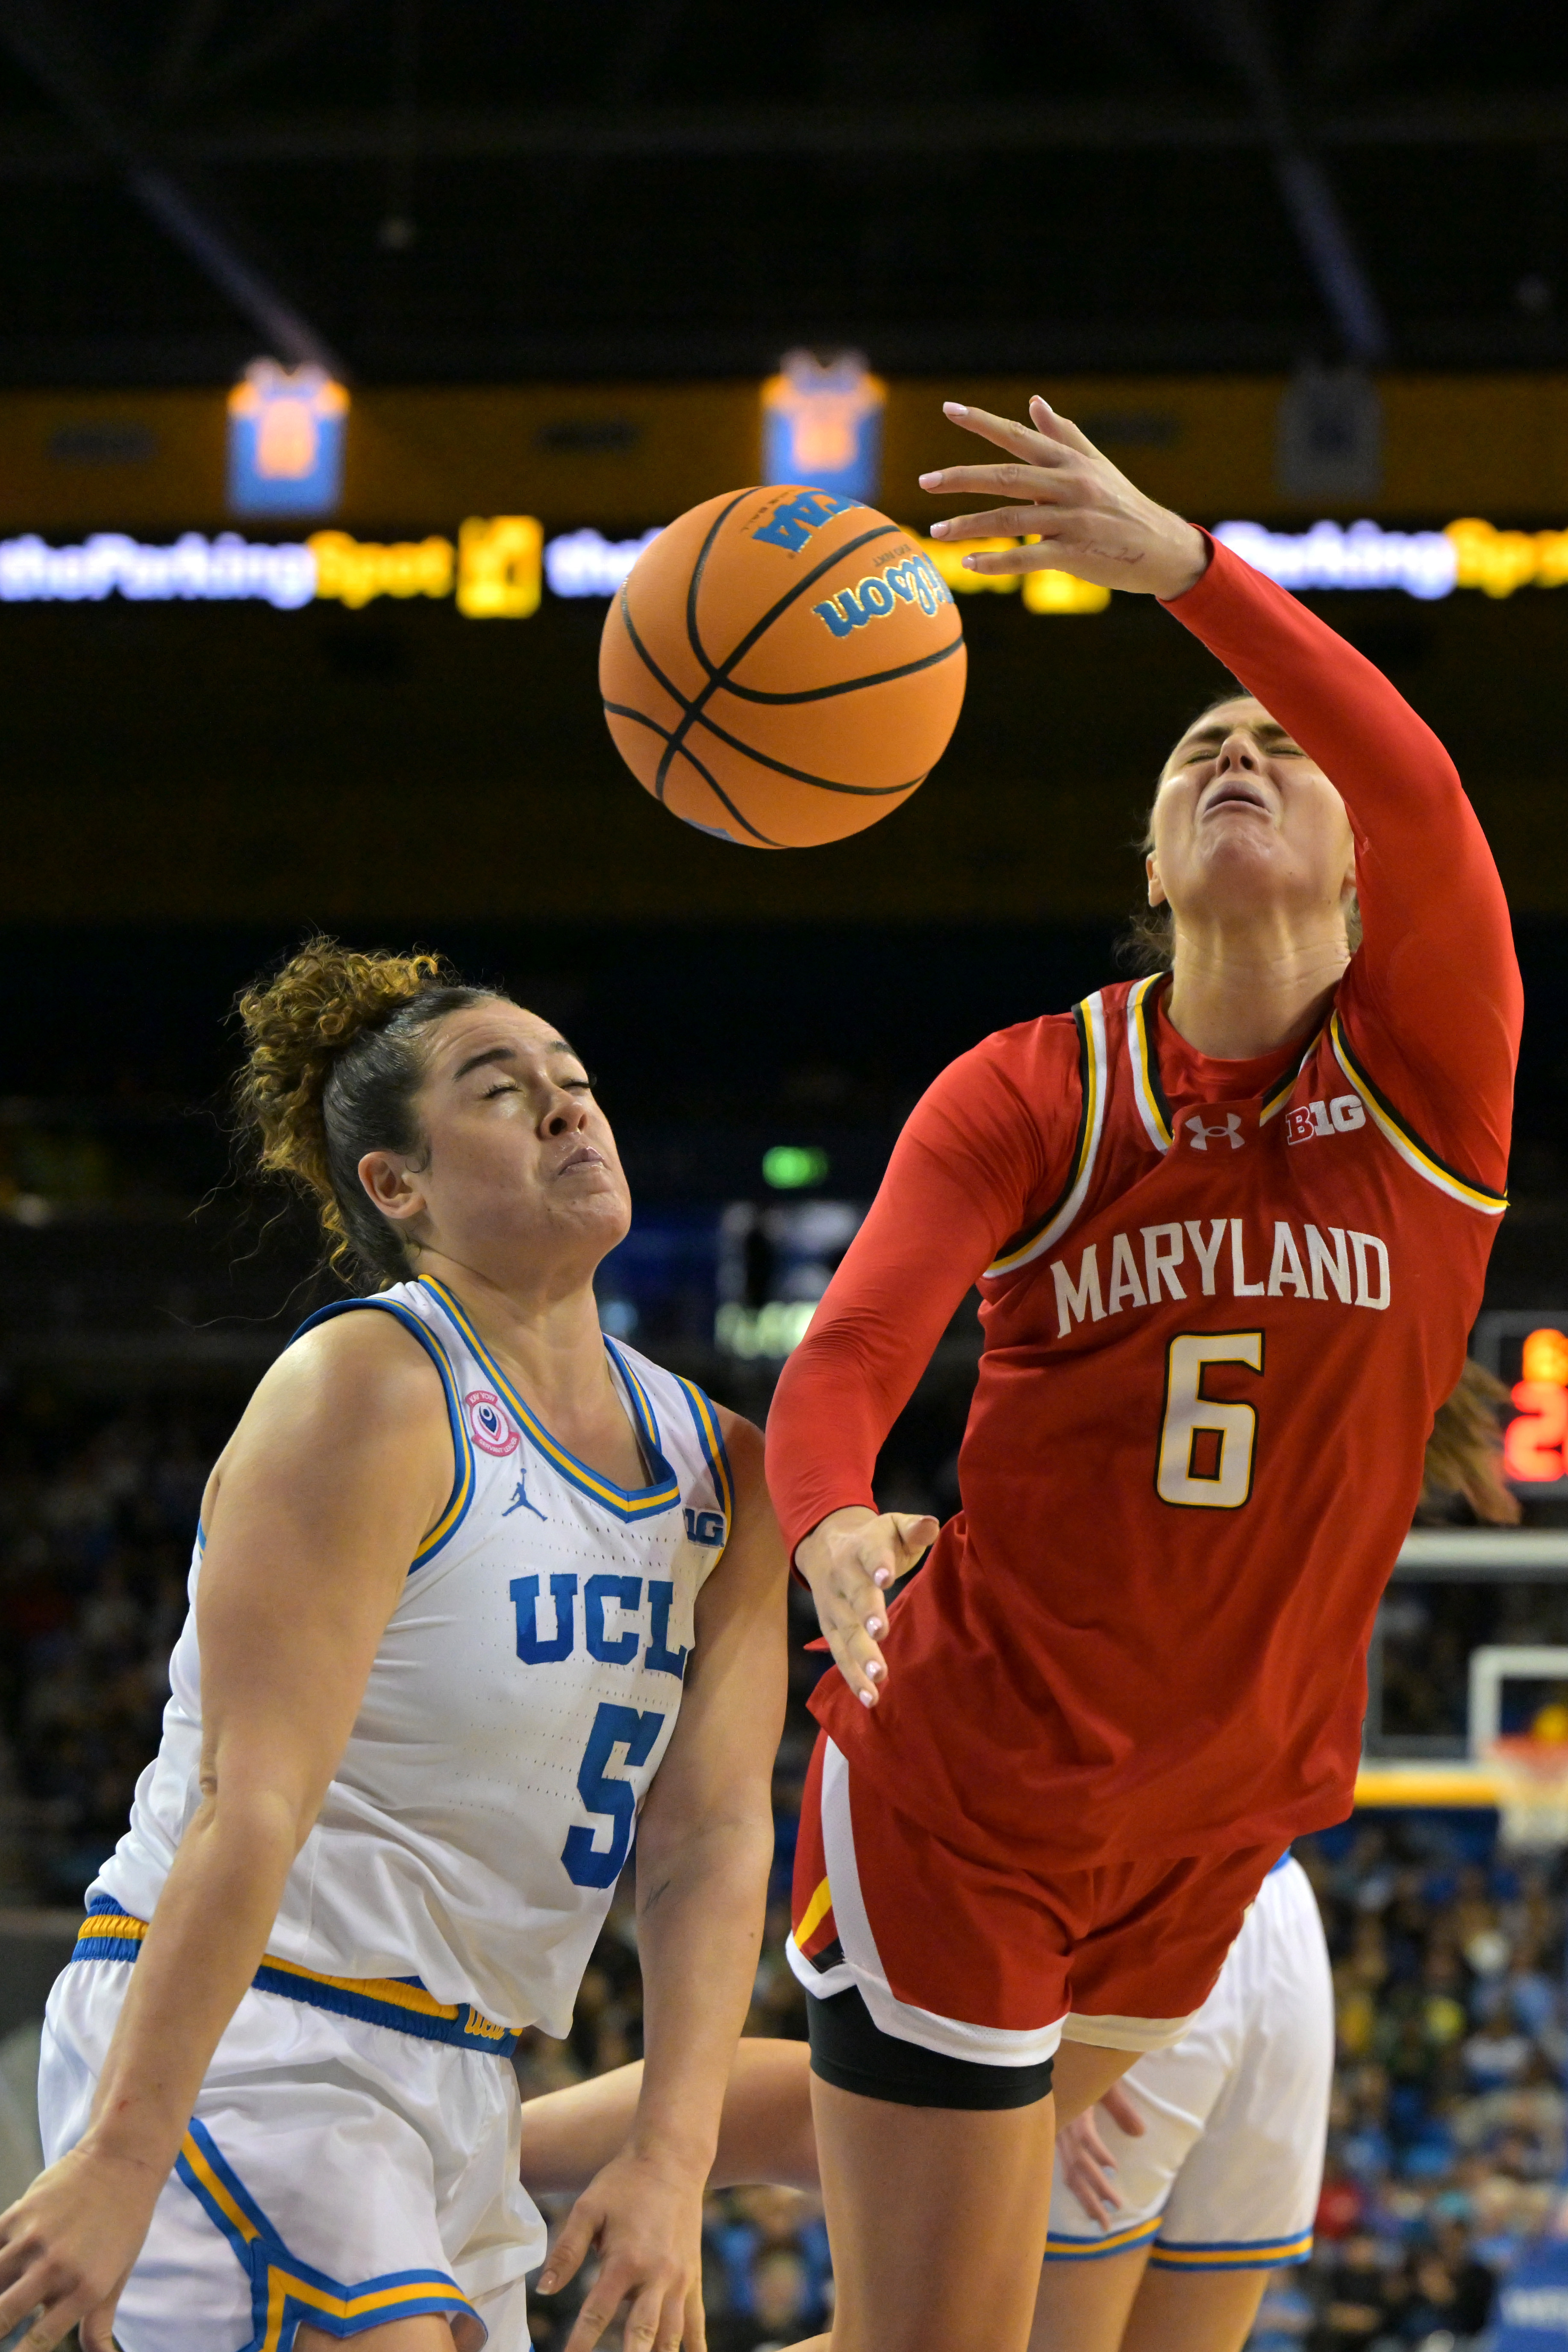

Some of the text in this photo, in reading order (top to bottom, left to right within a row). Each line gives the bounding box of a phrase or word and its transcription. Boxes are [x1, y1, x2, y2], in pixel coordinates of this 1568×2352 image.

[751, 490, 866, 553] CAA
[810, 552, 955, 639] ilson
[1050, 1218, 1390, 1339] MARYLAND
[1153, 1328, 1265, 1510] 6
[509, 1574, 688, 1681] UCL
[560, 1702, 665, 1890] 5
